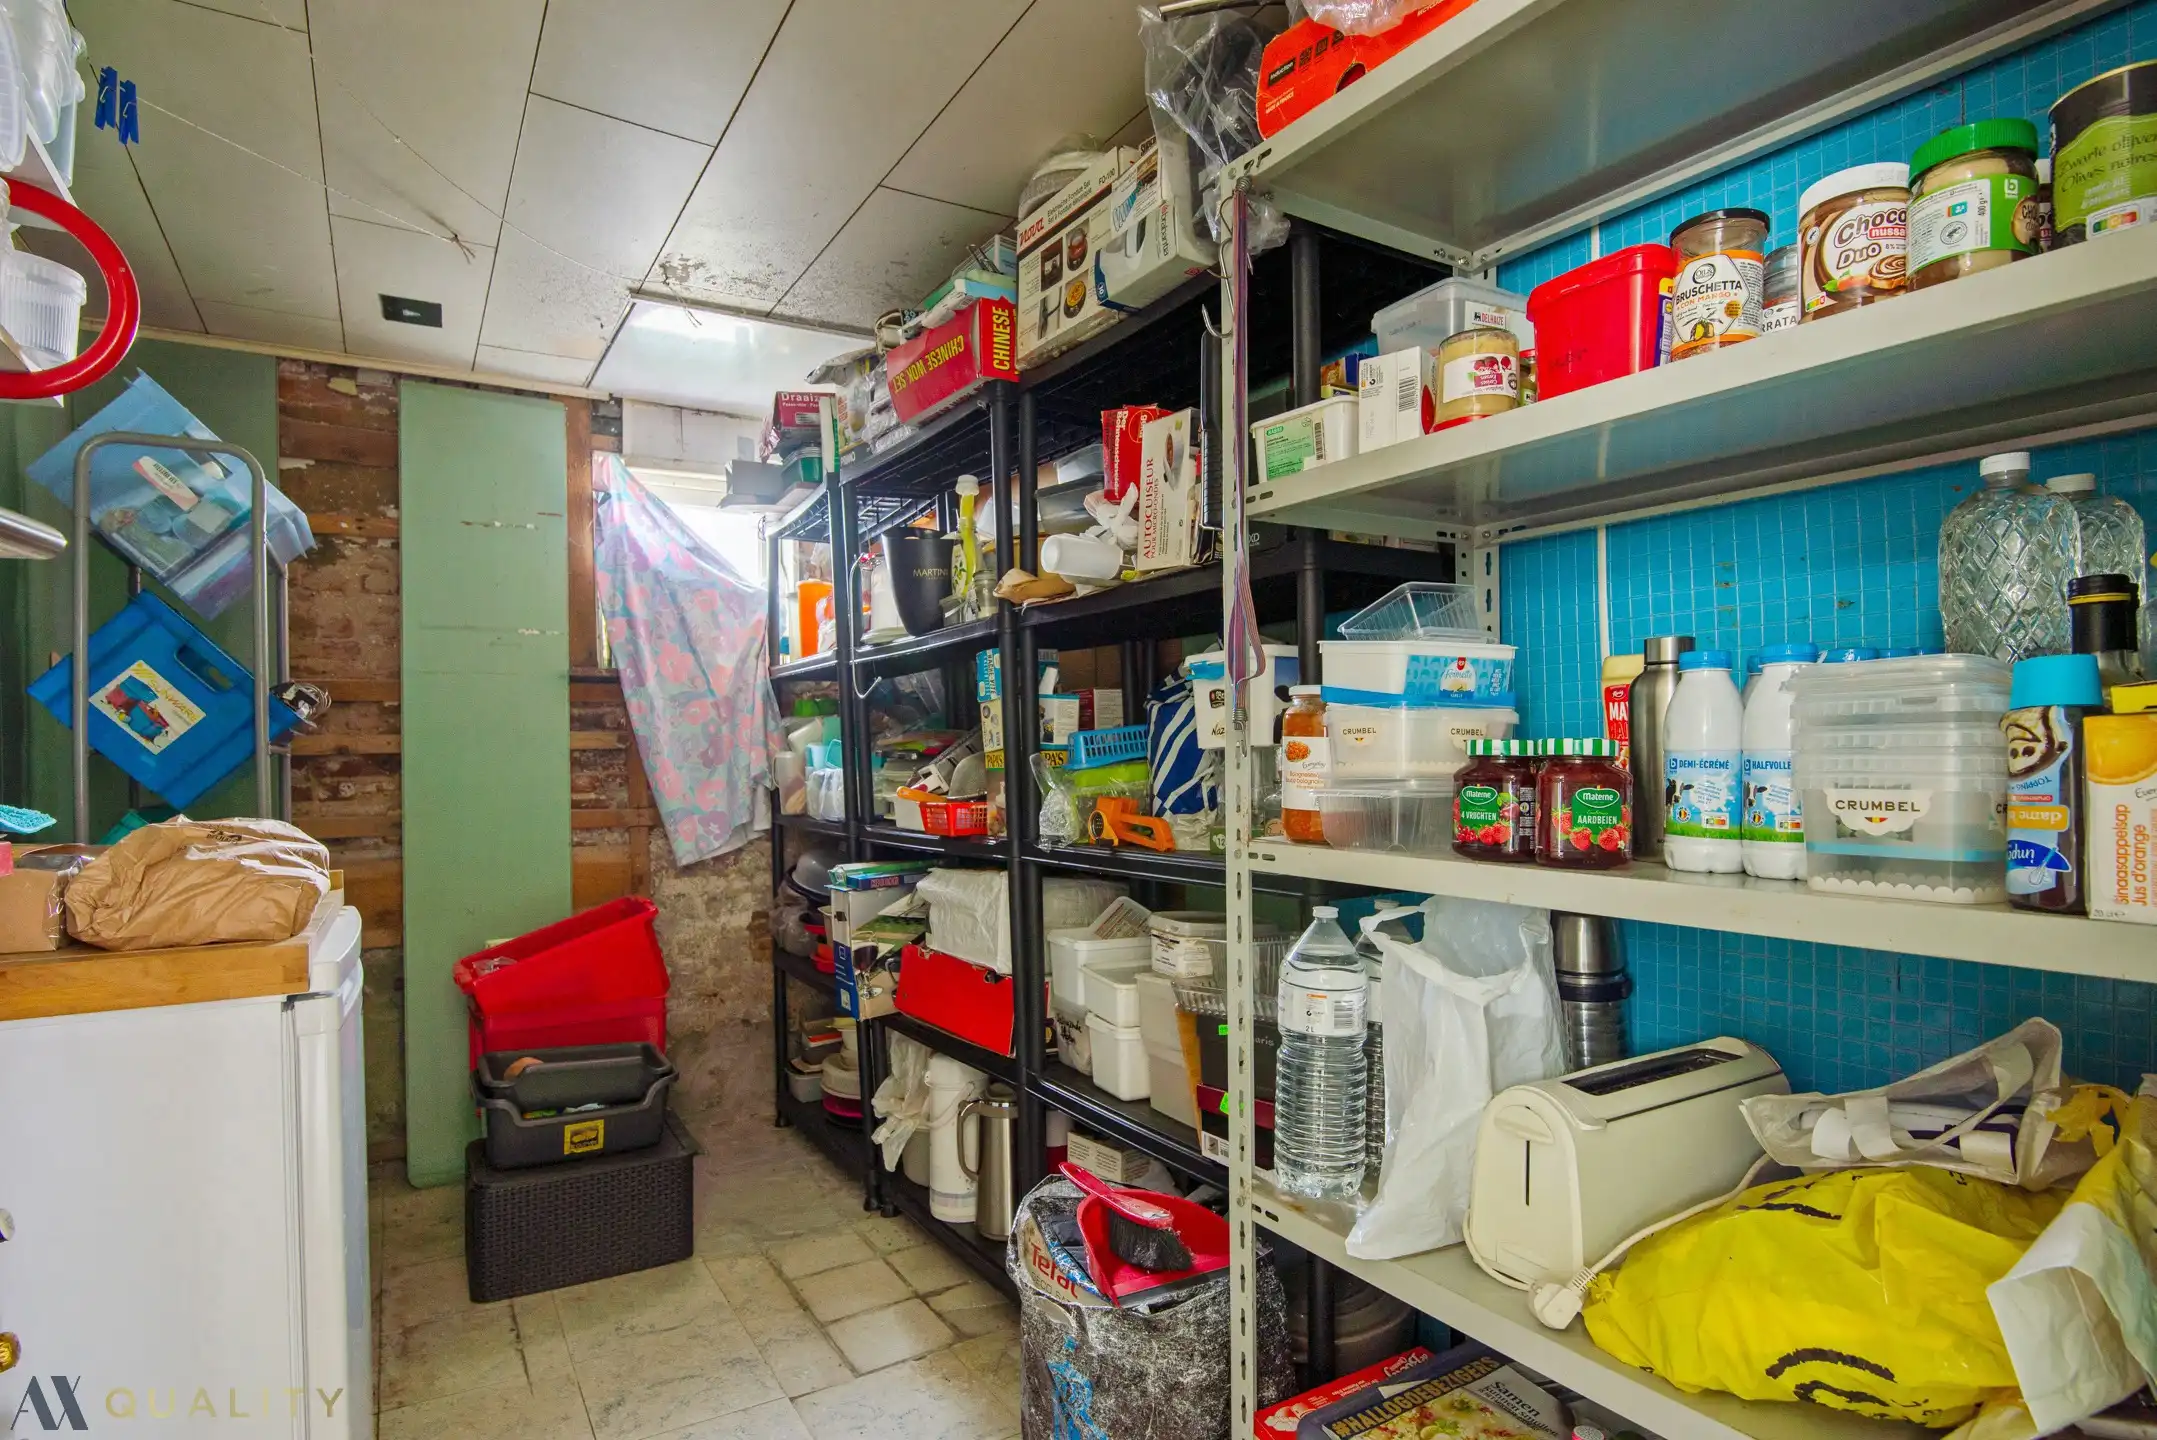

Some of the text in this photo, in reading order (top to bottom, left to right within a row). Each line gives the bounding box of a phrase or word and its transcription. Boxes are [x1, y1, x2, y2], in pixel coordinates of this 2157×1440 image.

[1836, 208, 1906, 247] Choco
[1837, 243, 1882, 270] Duo
[1675, 280, 1743, 305] BRUSCHETTA
[1680, 298, 1695, 309] CON
[1697, 291, 1731, 303] MANGO
[1481, 312, 1504, 326] DELHAIZE
[992, 306, 1011, 371] CHINESE
[892, 335, 965, 394] CHINESE WOK SET
[1121, 410, 1129, 430] Der
[1143, 458, 1154, 559] AUTOCUISEUR
[1151, 478, 1160, 537] MICRO-ONDES
[913, 568, 949, 577] MARTINI
[1342, 727, 1376, 736] CRUMBEL
[1450, 727, 1484, 736] CRUMBEL
[1679, 758, 1730, 770] DEMI-ÉCRÉMÉ
[1752, 760, 1792, 770] HALFVOLLE
[2016, 776, 2052, 790] TOPPING
[1466, 790, 1492, 799] Materne
[1582, 792, 1614, 802] Materne
[1835, 799, 1921, 813] CRUMBEL
[1466, 811, 1497, 821] VRUCHTEN
[1577, 815, 1618, 825] AARDBEIEN
[2019, 810, 2063, 824] dame
[2112, 804, 2131, 904] Sinaasappelsap
[2130, 824, 2150, 906] Jus d'orange
[1255, 1037, 1274, 1047] aris
[1331, 1356, 1500, 1438] #HALLOGOEBEZIGERS
[1494, 1381, 1540, 1417] Samen
[1484, 1385, 1521, 1416] kunnen
[1520, 1410, 1560, 1438] smullen
